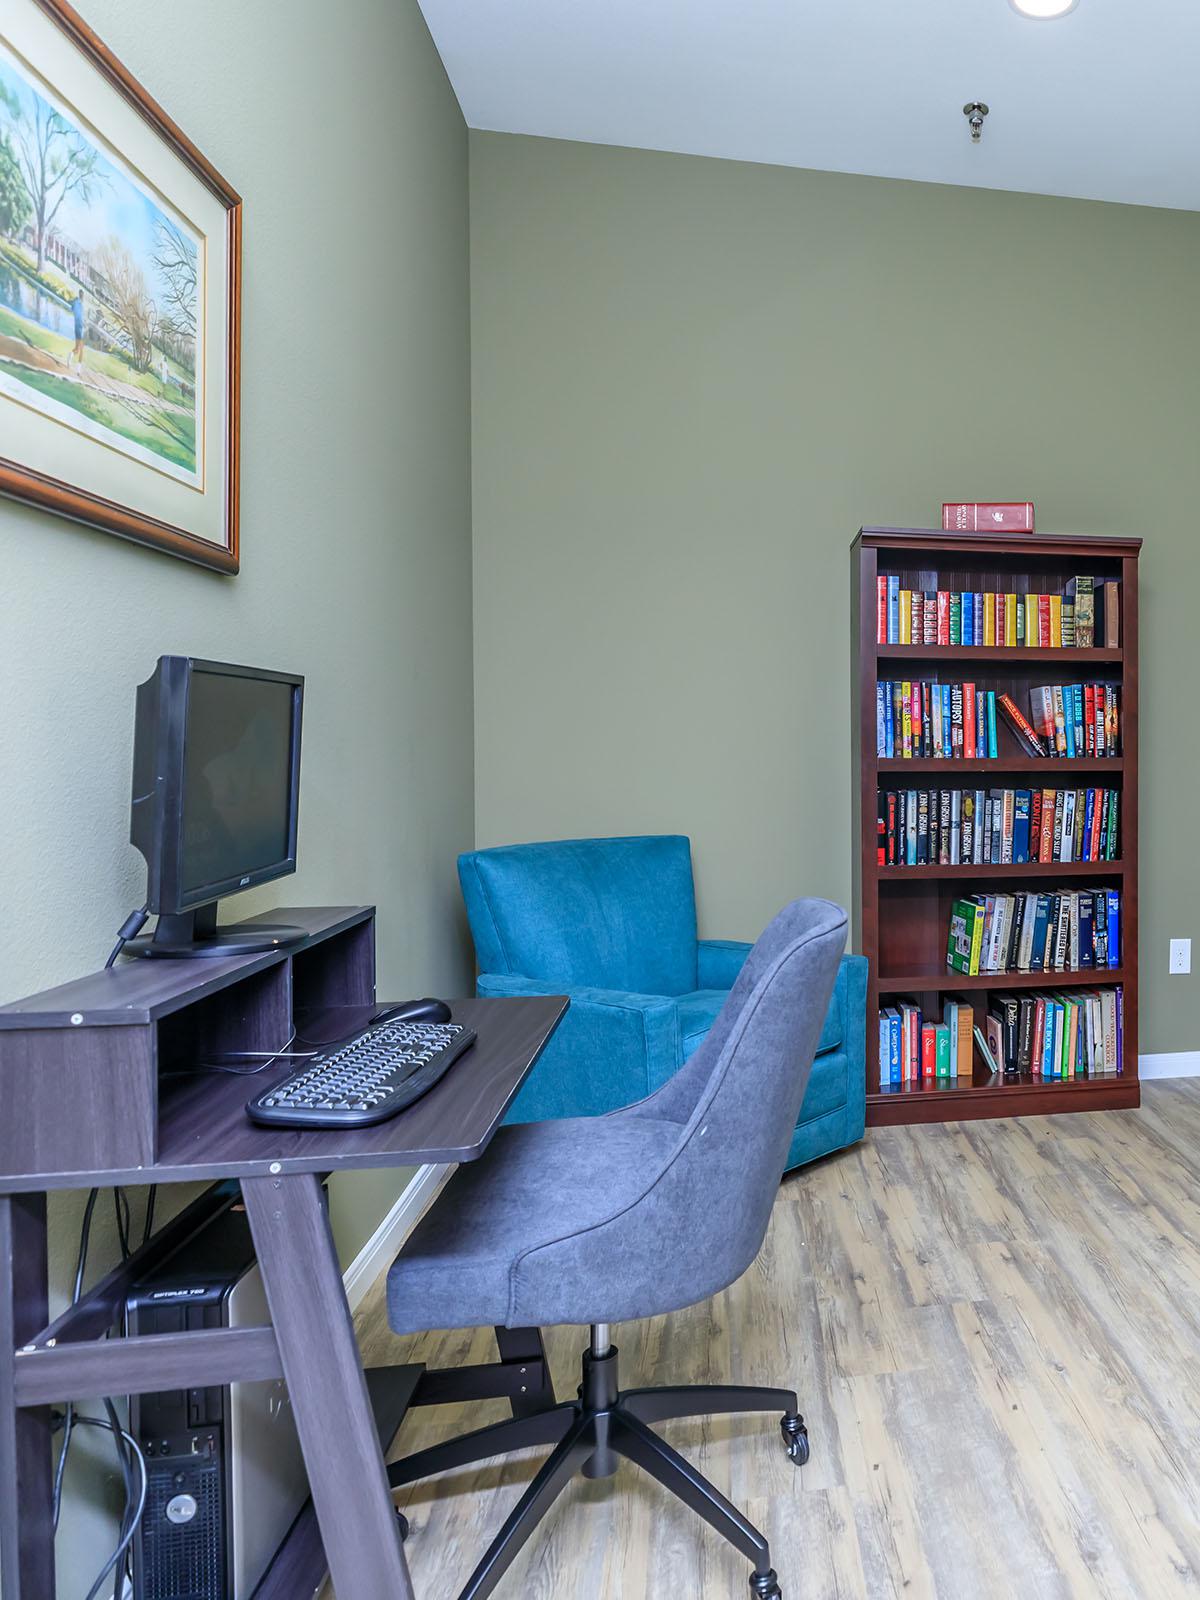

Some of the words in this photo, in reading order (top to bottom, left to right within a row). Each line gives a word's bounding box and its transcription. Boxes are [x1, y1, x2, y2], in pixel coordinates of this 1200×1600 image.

[952, 689, 962, 724] AUTOPSY
[919, 794, 927, 806] JOHN
[941, 792, 950, 805] JOHN
[1032, 793, 1040, 825] KOONTZ
[919, 814, 928, 835] GRISHAM
[941, 806, 950, 827] GRISHAM
[963, 822, 972, 834] JOHN
[963, 835, 972, 855] GRISHAM
[1007, 1003, 1017, 1026] Delia
